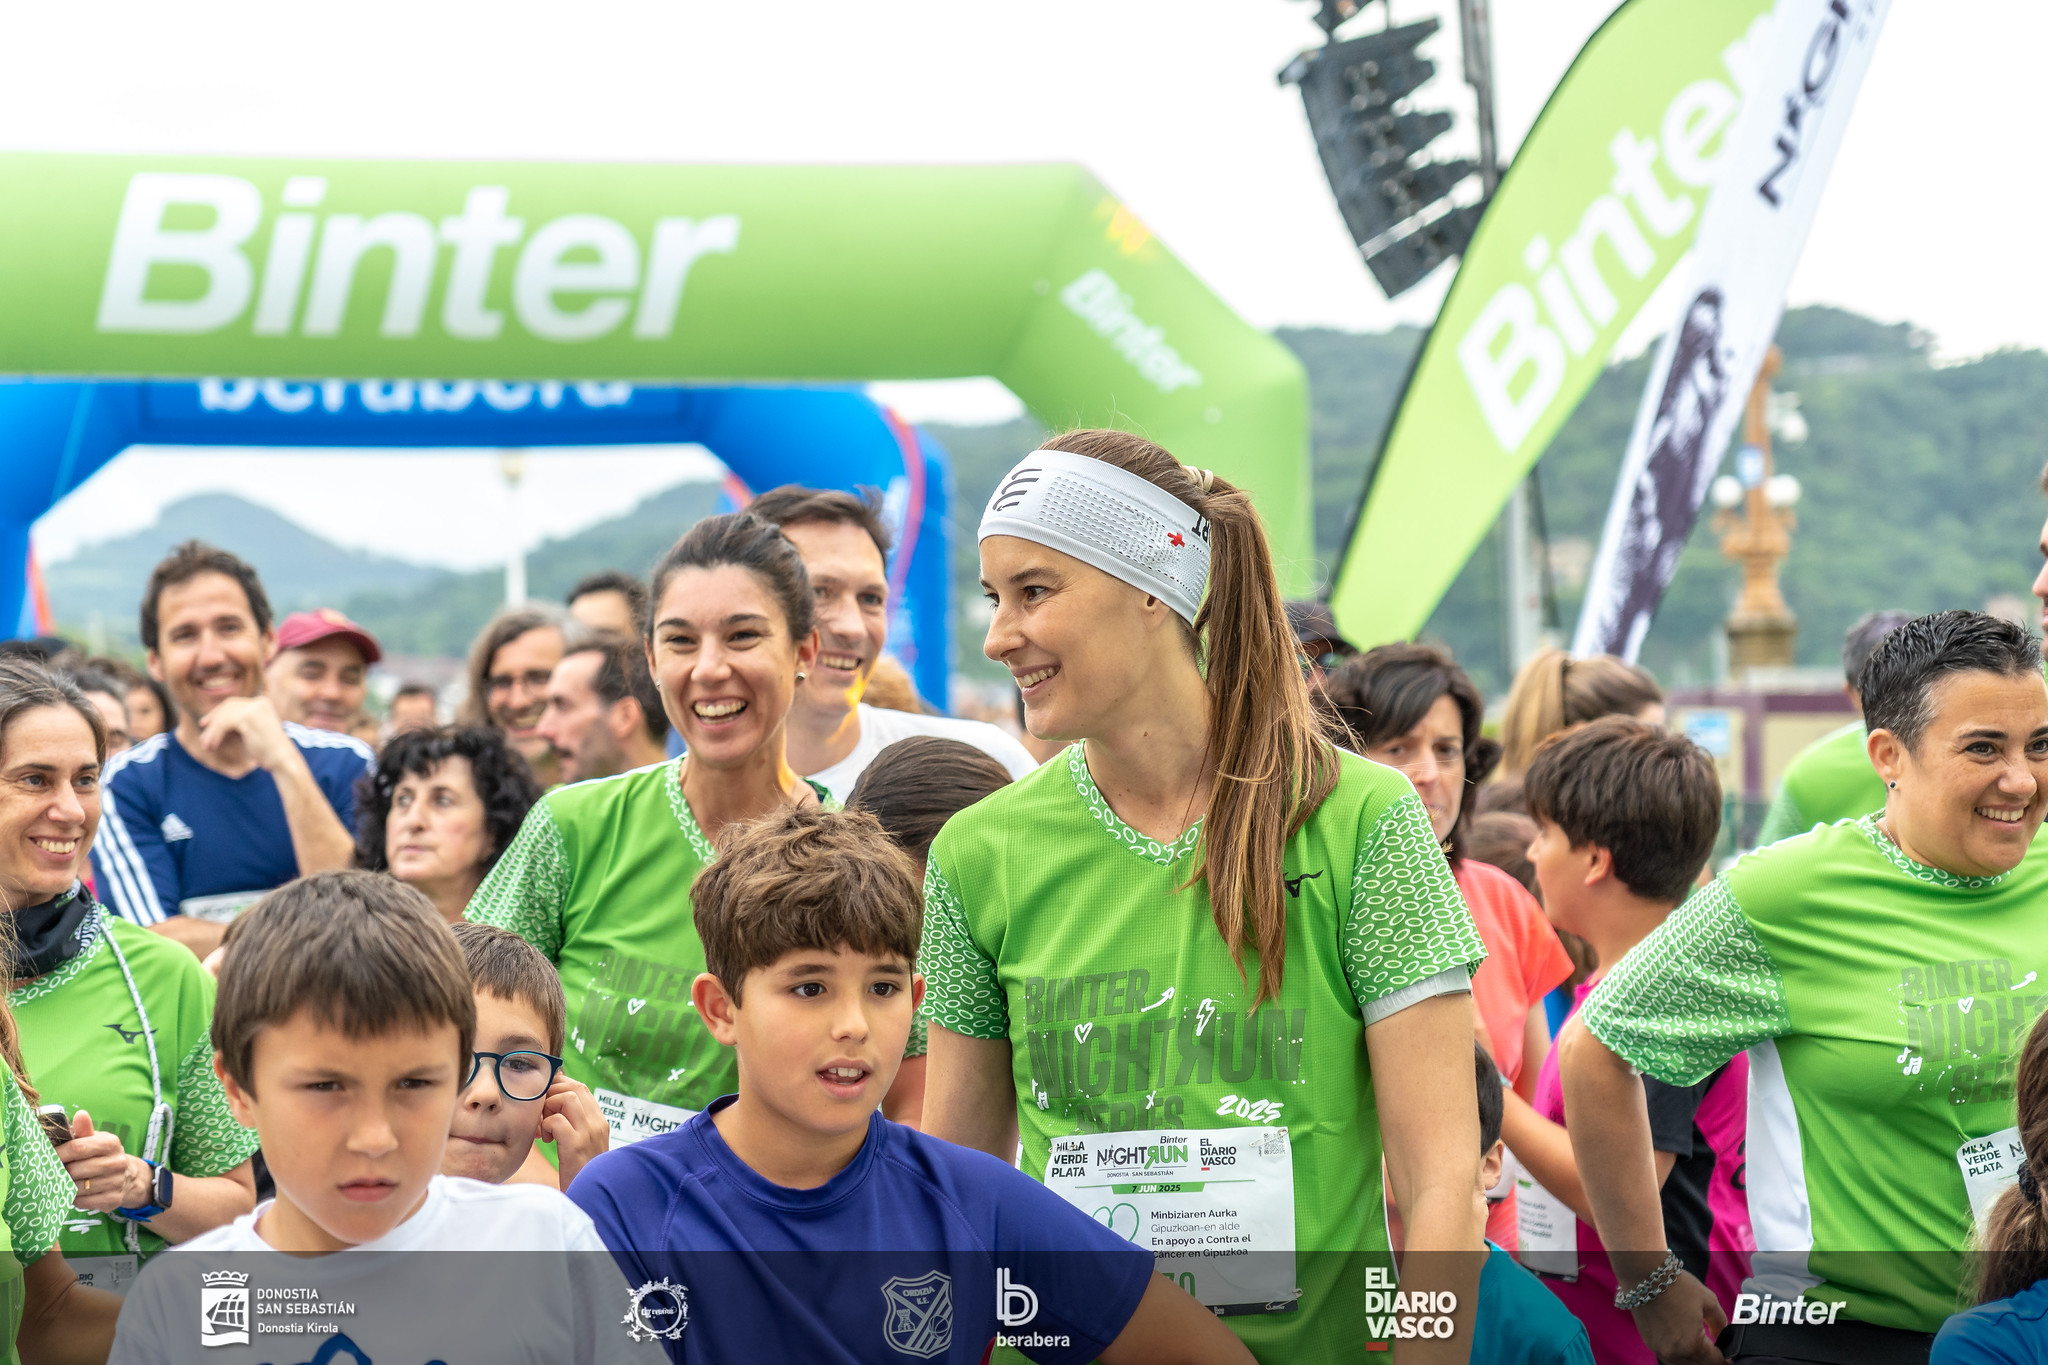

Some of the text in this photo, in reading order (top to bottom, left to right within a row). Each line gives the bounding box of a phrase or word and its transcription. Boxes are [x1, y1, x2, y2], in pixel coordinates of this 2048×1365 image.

[1456, 10, 1776, 453] Binter
[96, 171, 741, 341] Binter
[1060, 268, 1201, 393] Binter
[1901, 959, 2014, 1004] BINTER
[1025, 969, 1150, 1025] BINTER
[598, 1095, 625, 1109] MILLA
[1216, 1095, 1284, 1124] 2025
[1160, 1136, 1188, 1144] Binter
[1200, 1138, 1212, 1146] EL
[1200, 1146, 1237, 1156] DIARIO
[1054, 1154, 1088, 1164] VERDE
[1201, 1156, 1236, 1166] VASCO
[1965, 1150, 2002, 1166] VERDE
[1051, 1167, 1086, 1177] PLATA
[1968, 1162, 2004, 1177] PLATA
[1132, 1185, 1137, 1193] 7
[1138, 1185, 1157, 1193] JUN
[1151, 1209, 1237, 1219] Minbiziaren Aurka
[1151, 1222, 1240, 1234] Gipuzkoan-en alde
[1152, 1237, 1163, 1246] En
[1166, 1237, 1195, 1247] apoyo
[1206, 1235, 1239, 1244] Contra
[1241, 1234, 1251, 1242] el
[1153, 1249, 1186, 1258] Cáncer
[1203, 1248, 1248, 1259] Gipuzkoa
